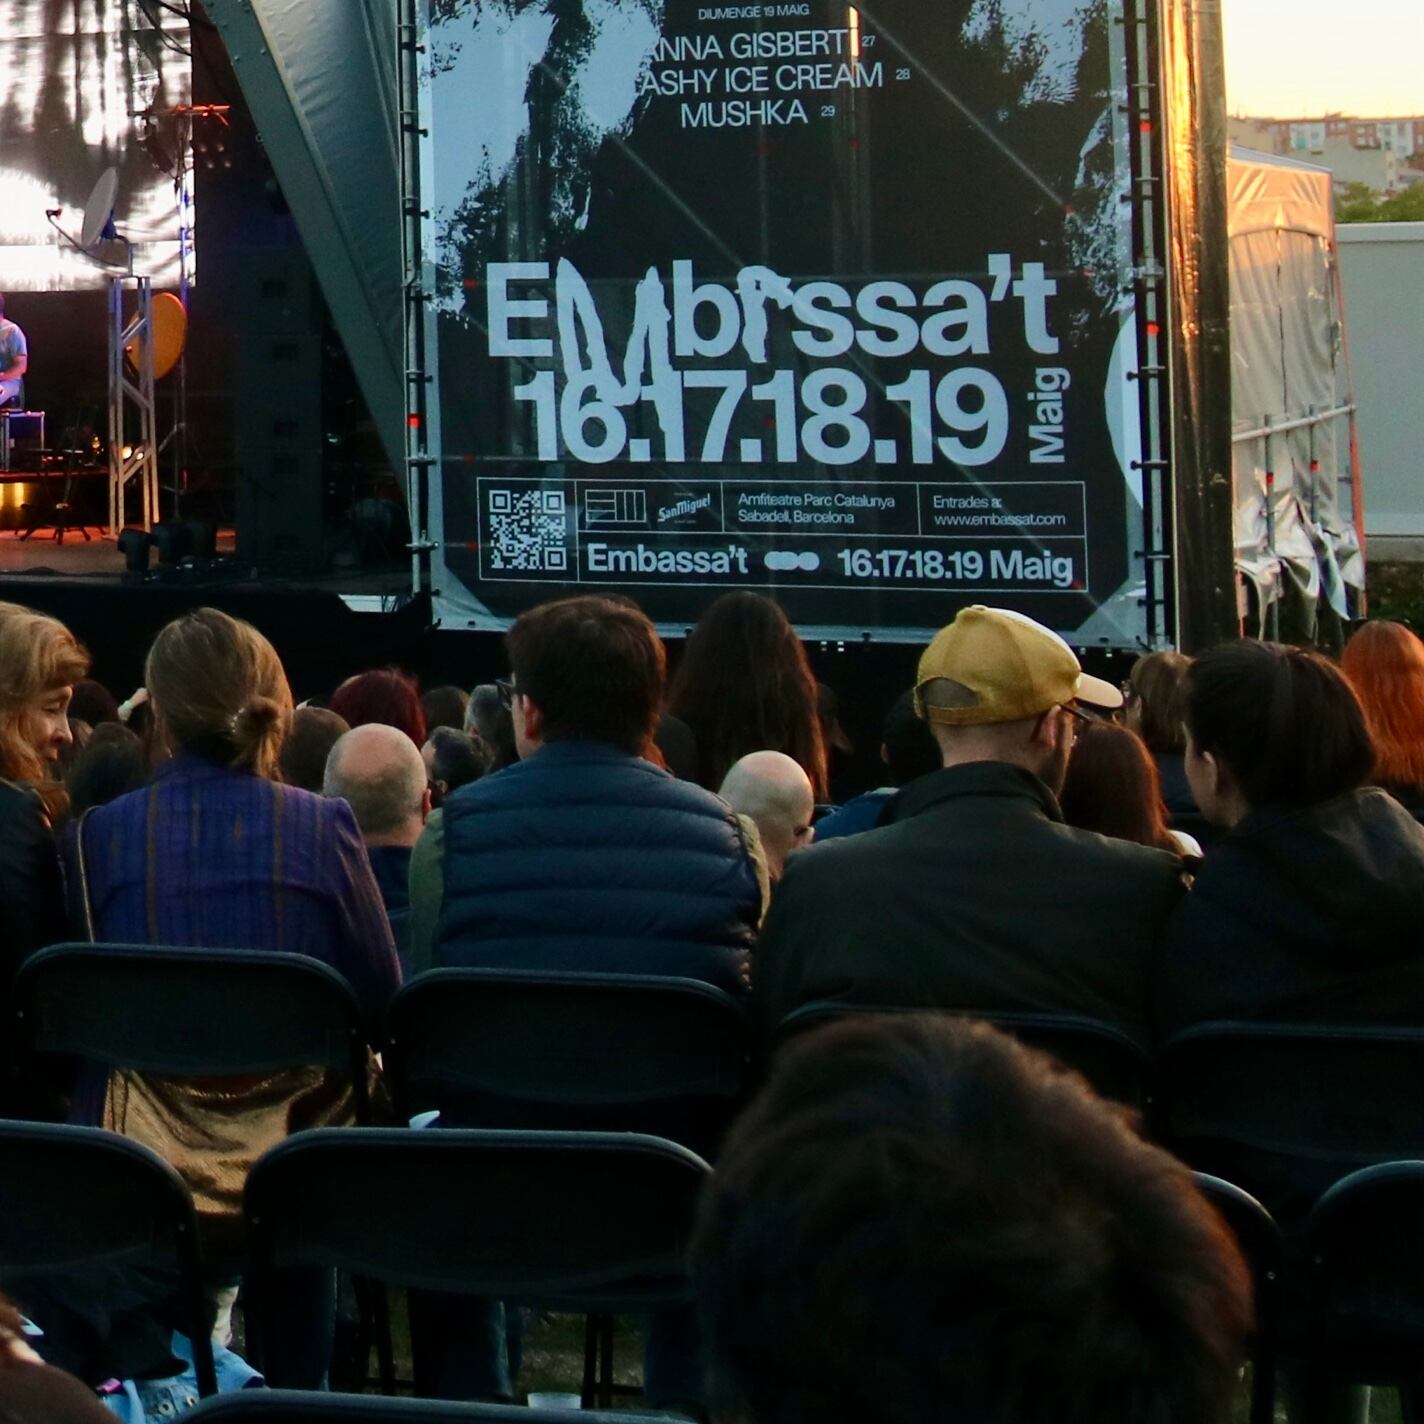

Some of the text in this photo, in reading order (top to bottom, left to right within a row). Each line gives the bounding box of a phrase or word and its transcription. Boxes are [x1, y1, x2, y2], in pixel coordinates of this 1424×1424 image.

[698, 3, 811, 20] DIUMENGE MAIG
[729, 28, 876, 61] GISBERT 27
[725, 61, 911, 93] ICE CREAM 28
[680, 98, 836, 129] MUSHKA 29
[514, 365, 1071, 467] 16.17.18.19 Maig
[737, 492, 896, 511] Amfiteatre Parc Catalunya
[932, 494, 989, 509] Entrades
[793, 509, 855, 525] Barcelona
[934, 512, 1066, 526] www.embassat.com
[586, 542, 1074, 588] Embassa't 16.17.18.19 Maig
